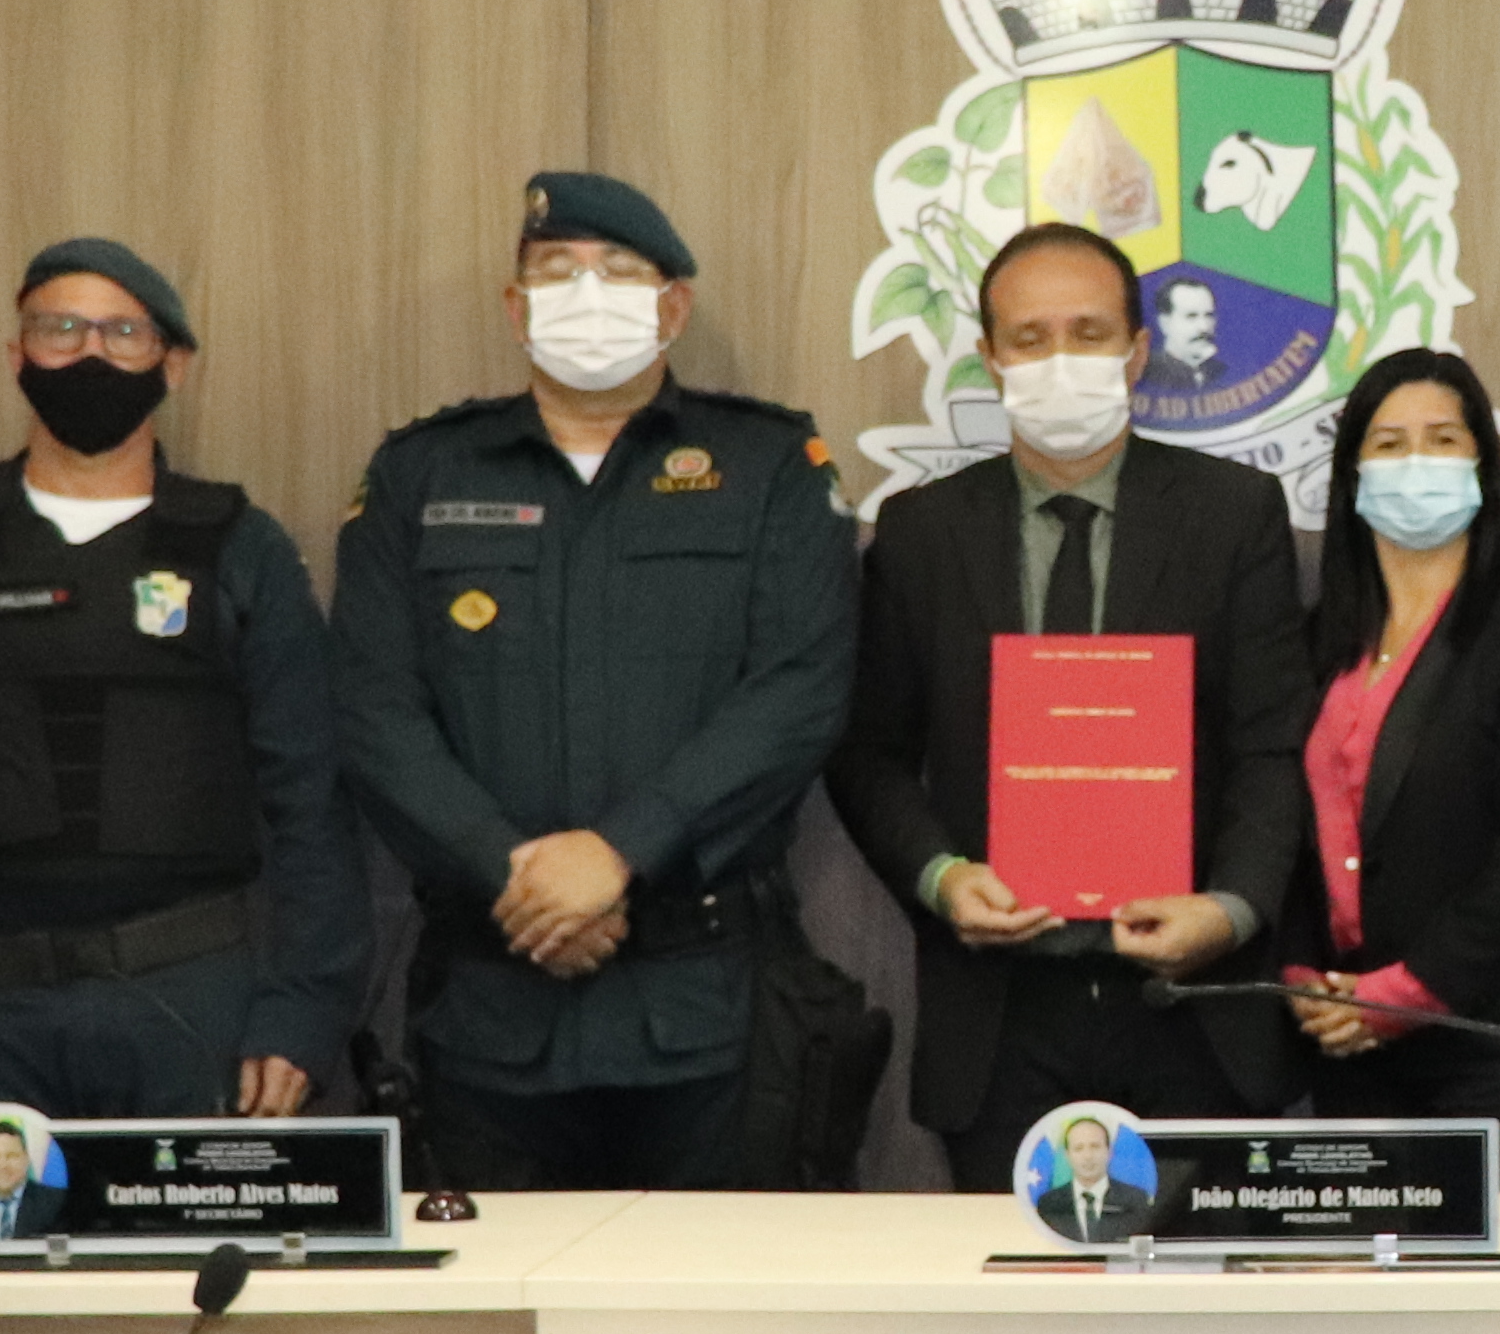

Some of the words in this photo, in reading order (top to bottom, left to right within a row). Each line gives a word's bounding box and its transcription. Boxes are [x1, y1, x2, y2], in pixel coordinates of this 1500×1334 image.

[106, 1183, 162, 1205] Carlos
[164, 1183, 236, 1205] Roberto
[239, 1182, 285, 1204] Alves
[287, 1182, 339, 1204] Matos
[1191, 1185, 1235, 1211] João
[1237, 1185, 1317, 1211] Olegário
[1319, 1186, 1344, 1208] de
[1346, 1185, 1399, 1207] Matos
[1402, 1185, 1443, 1207] Neto
[1282, 1212, 1352, 1223] PRESIDENTE
